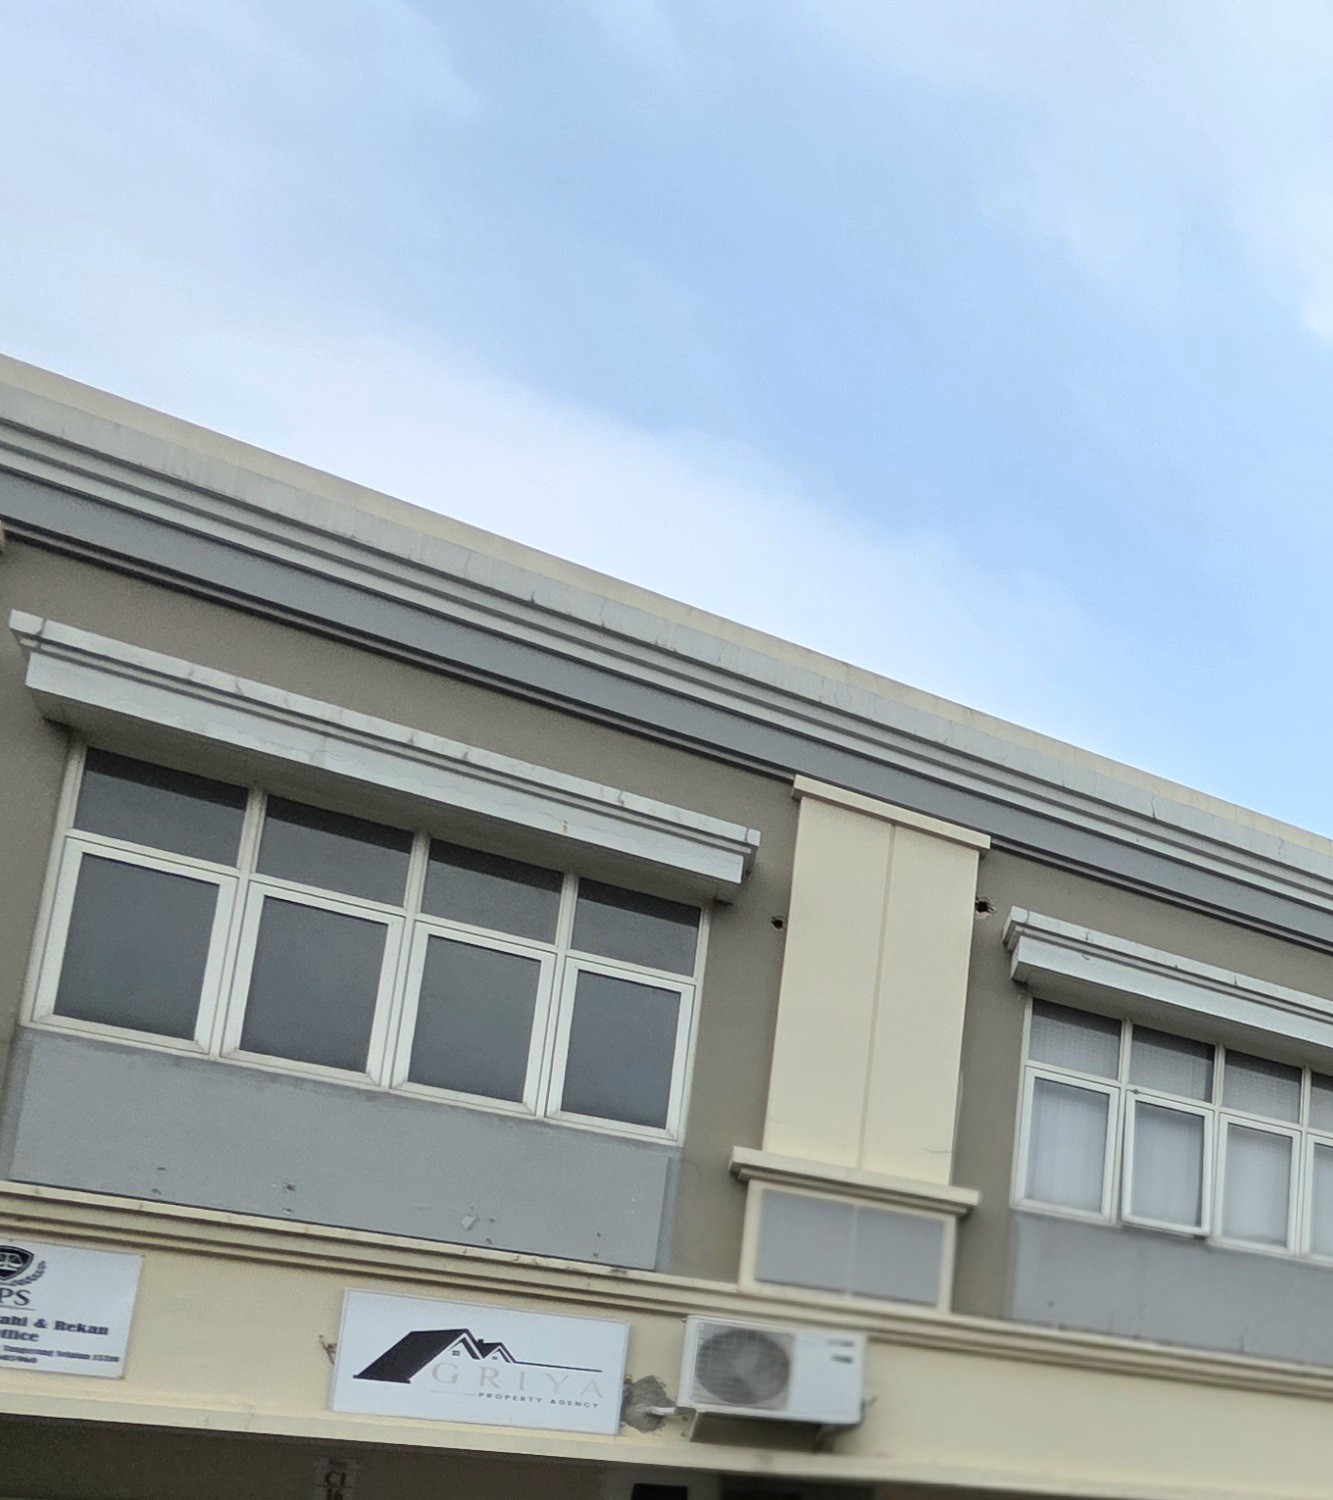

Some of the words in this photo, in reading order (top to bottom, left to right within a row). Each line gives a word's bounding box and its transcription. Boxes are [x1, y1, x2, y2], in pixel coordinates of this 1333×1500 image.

[33, 1318, 47, 1329] &
[431, 1362, 604, 1398] GRIYA
[478, 1391, 542, 1404] PROPERTY
[549, 1398, 599, 1409] AGENCY
